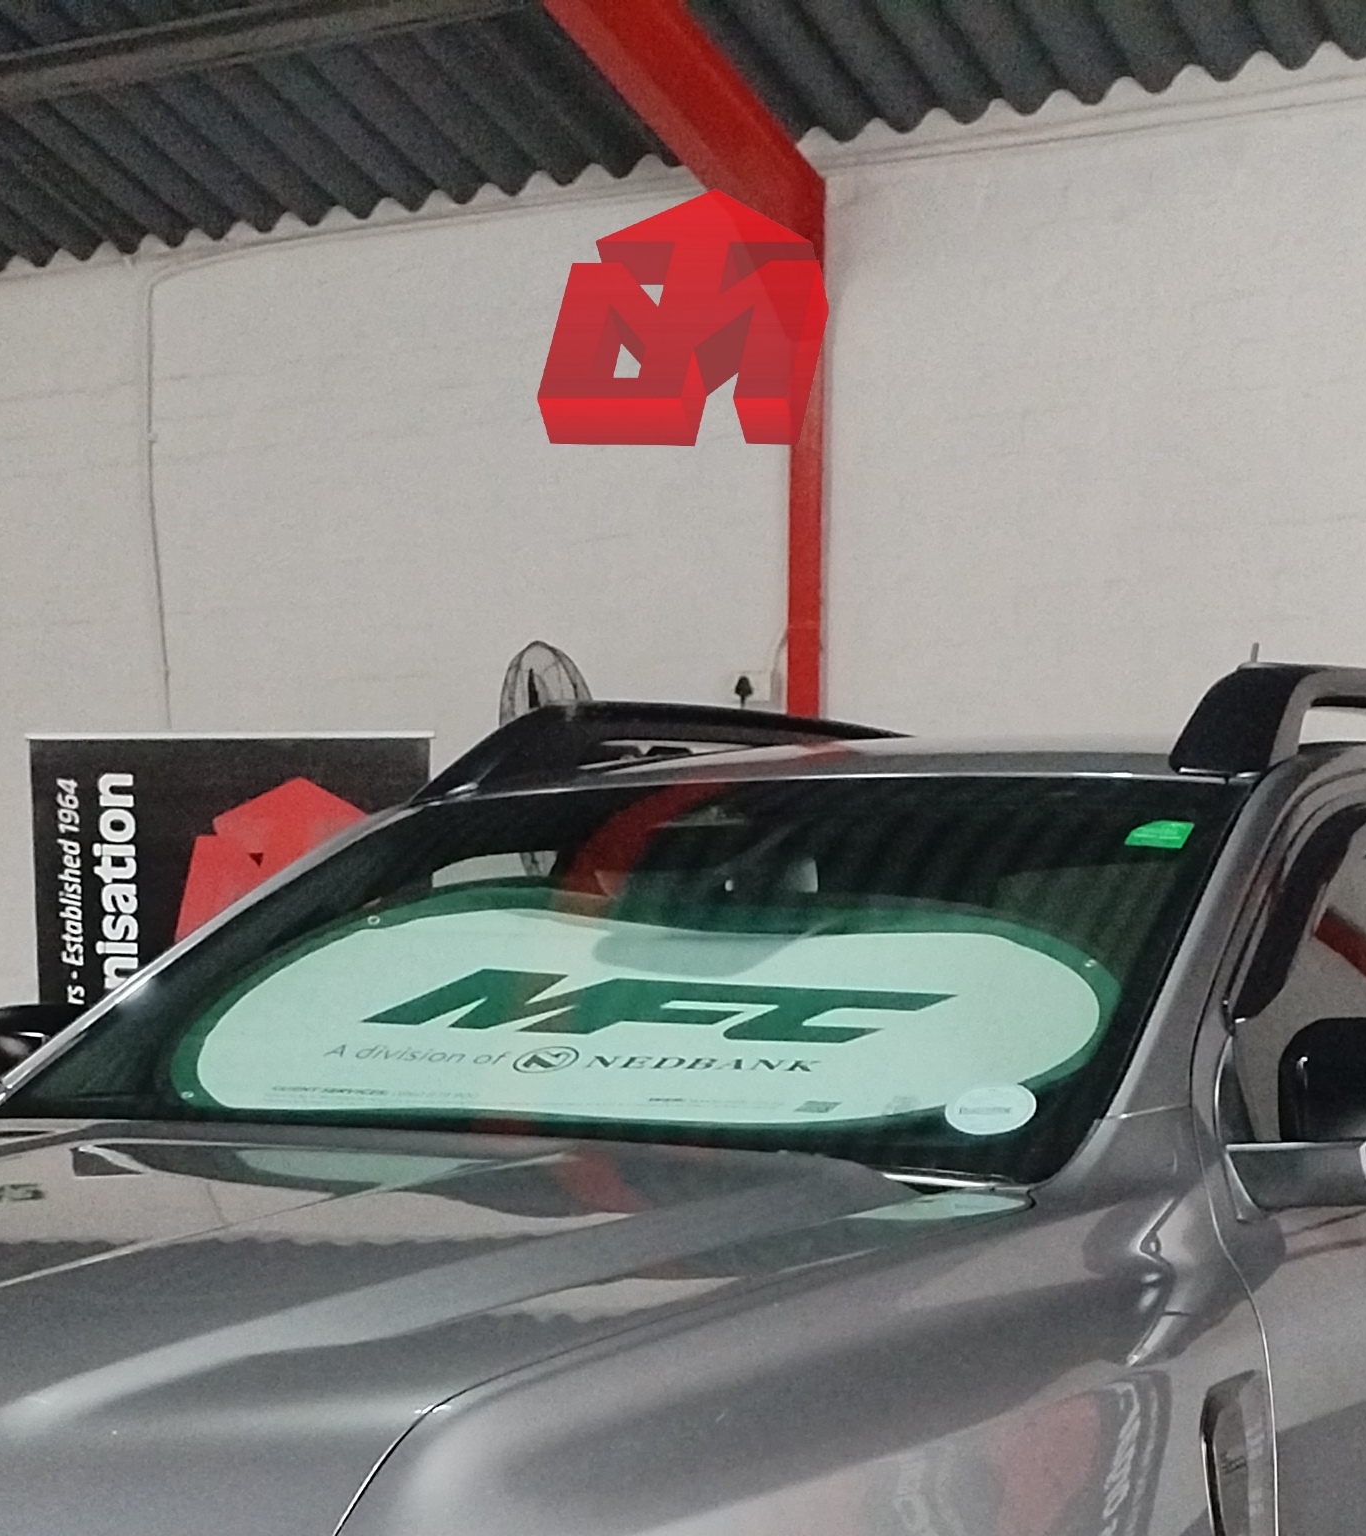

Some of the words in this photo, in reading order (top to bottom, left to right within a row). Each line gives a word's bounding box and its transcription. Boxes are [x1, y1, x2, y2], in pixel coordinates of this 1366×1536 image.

[56, 777, 79, 835] 1964
[58, 838, 85, 967] Established
[361, 968, 957, 1043] MFC
[355, 1045, 466, 1063] division
[473, 1051, 514, 1066] of
[586, 1055, 822, 1073] NEDBANK
